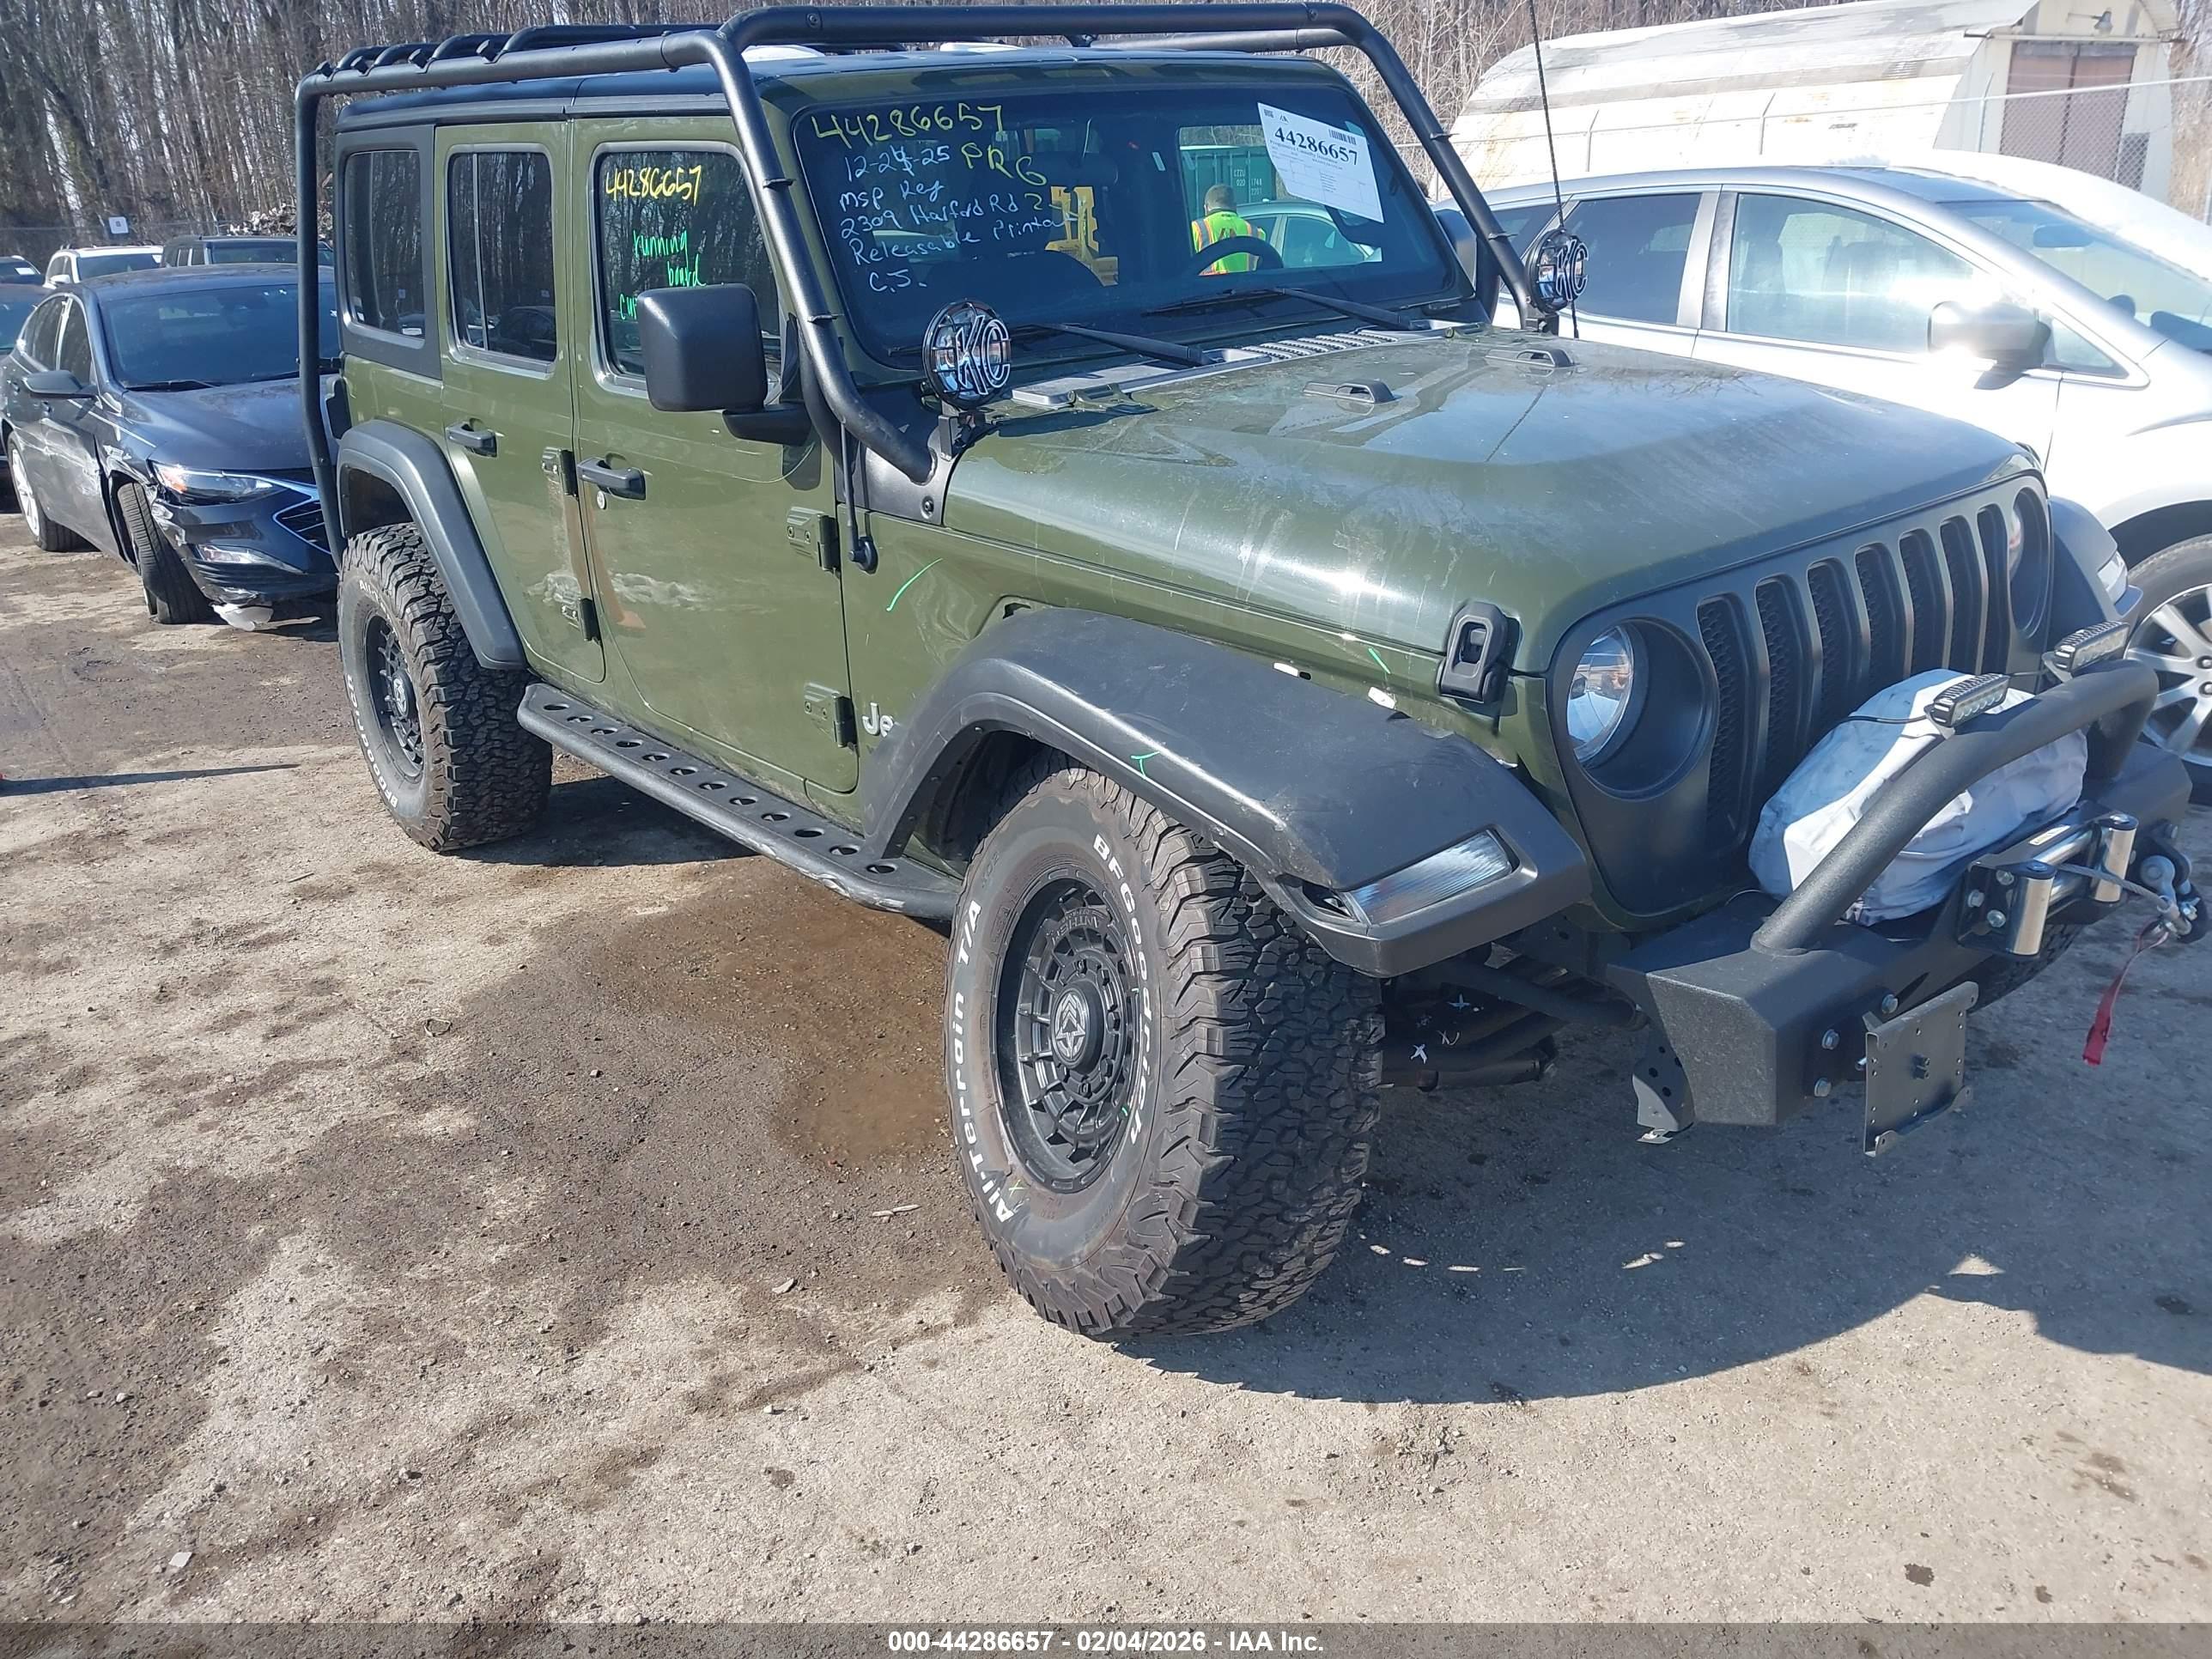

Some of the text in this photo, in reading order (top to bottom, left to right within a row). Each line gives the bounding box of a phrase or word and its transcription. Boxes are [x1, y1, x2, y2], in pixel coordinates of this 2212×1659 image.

[811, 101, 1004, 149] 44286657
[1274, 126, 1358, 166] 44286657
[605, 164, 702, 207] 44286657
[988, 193, 1019, 214] Rd
[632, 229, 690, 270] running
[848, 230, 982, 266] Releasable
[1555, 239, 1589, 302] KC
[666, 254, 708, 288] board
[955, 314, 1012, 396] KC
[957, 900, 982, 966] T/A
[1093, 834, 1152, 1145] BFGoodrich
[952, 991, 1014, 1224] All-Terrain
